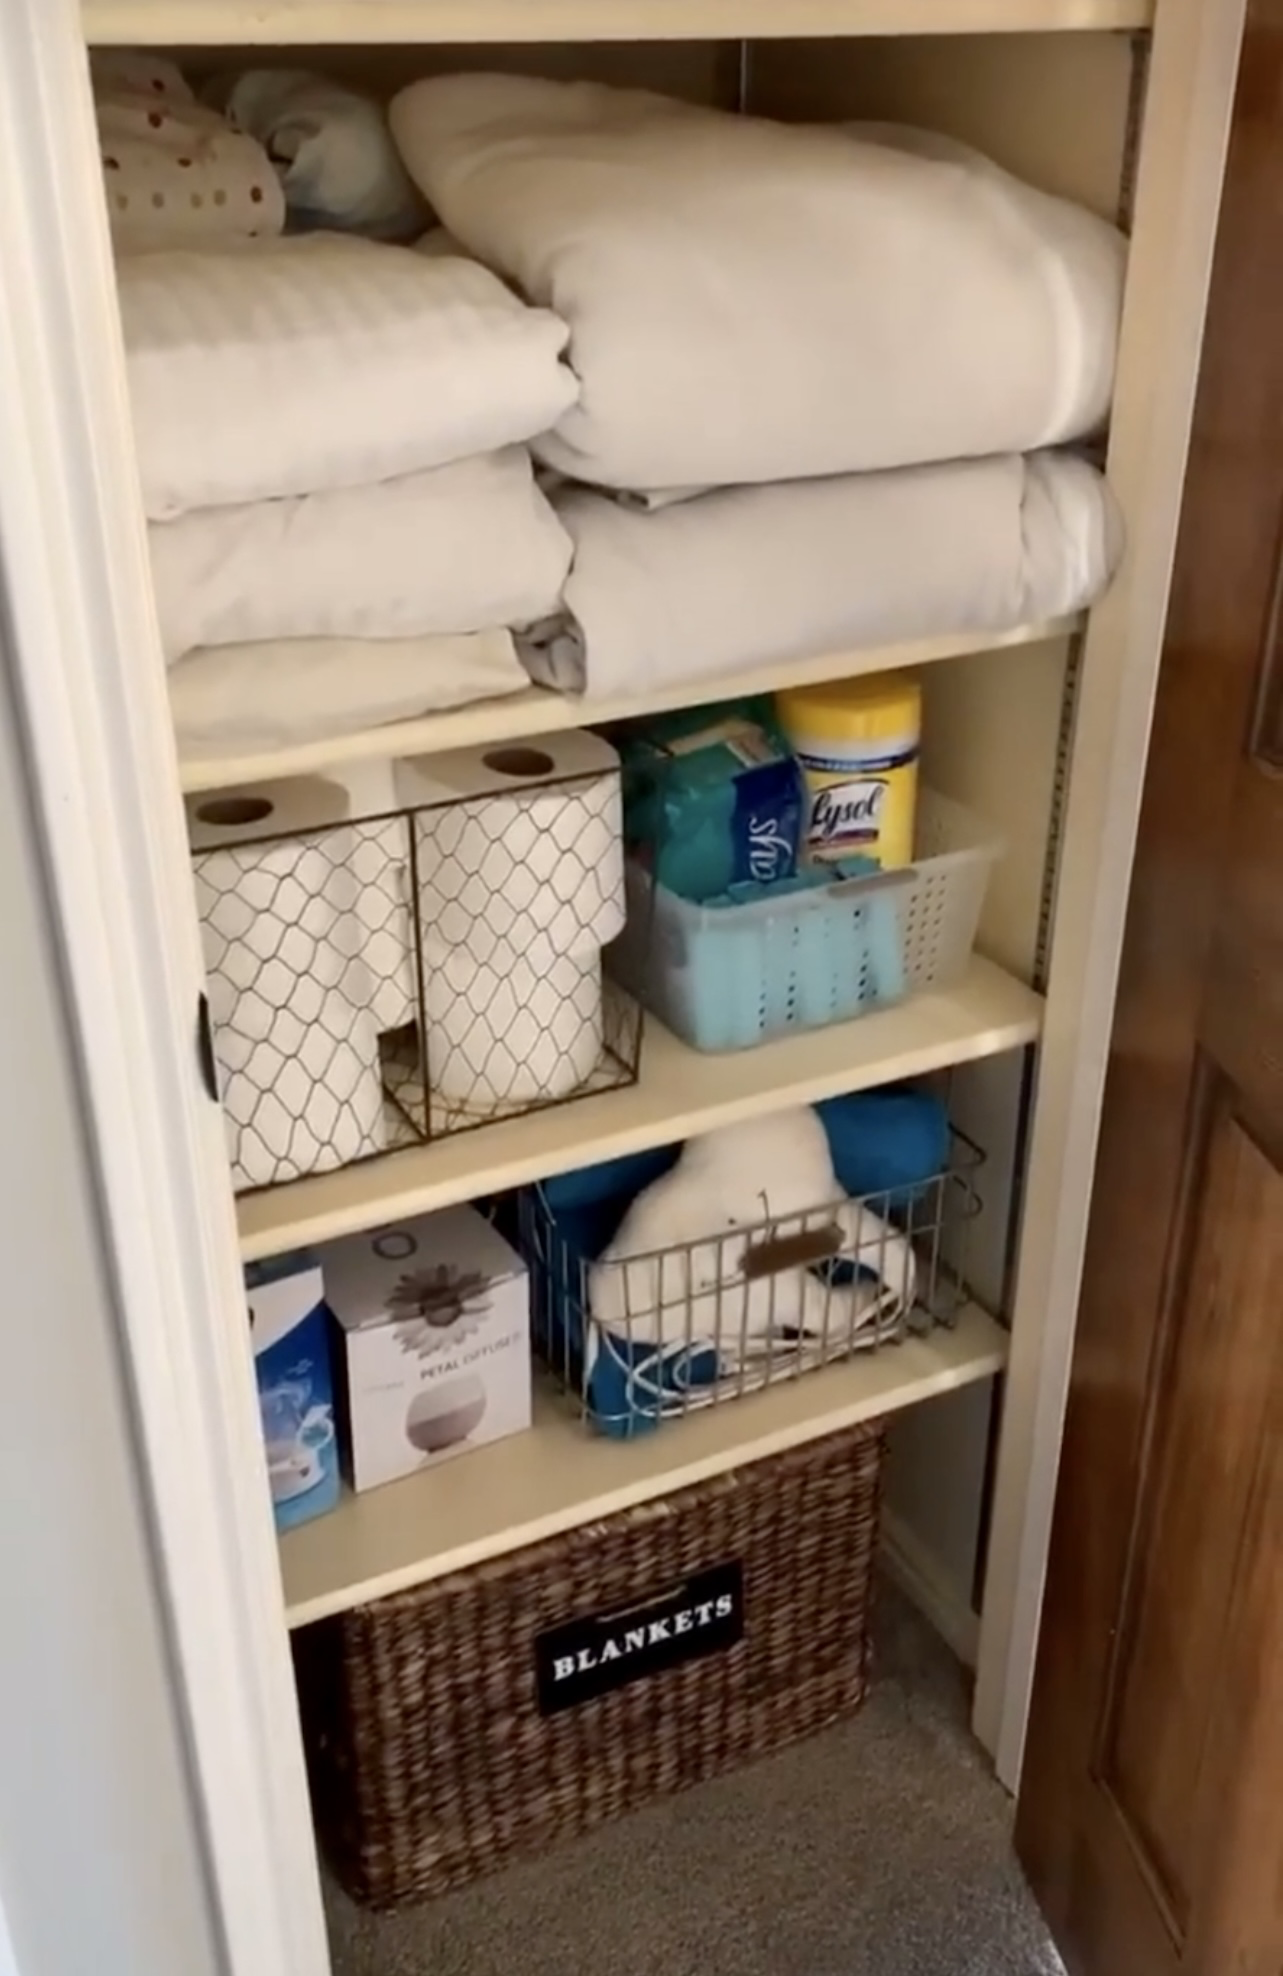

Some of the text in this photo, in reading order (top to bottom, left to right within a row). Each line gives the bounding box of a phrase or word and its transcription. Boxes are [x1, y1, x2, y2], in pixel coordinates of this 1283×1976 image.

[811, 784, 883, 833] Lysol
[420, 1359, 460, 1380] PETAL
[553, 1593, 733, 1681] BLANKETS
